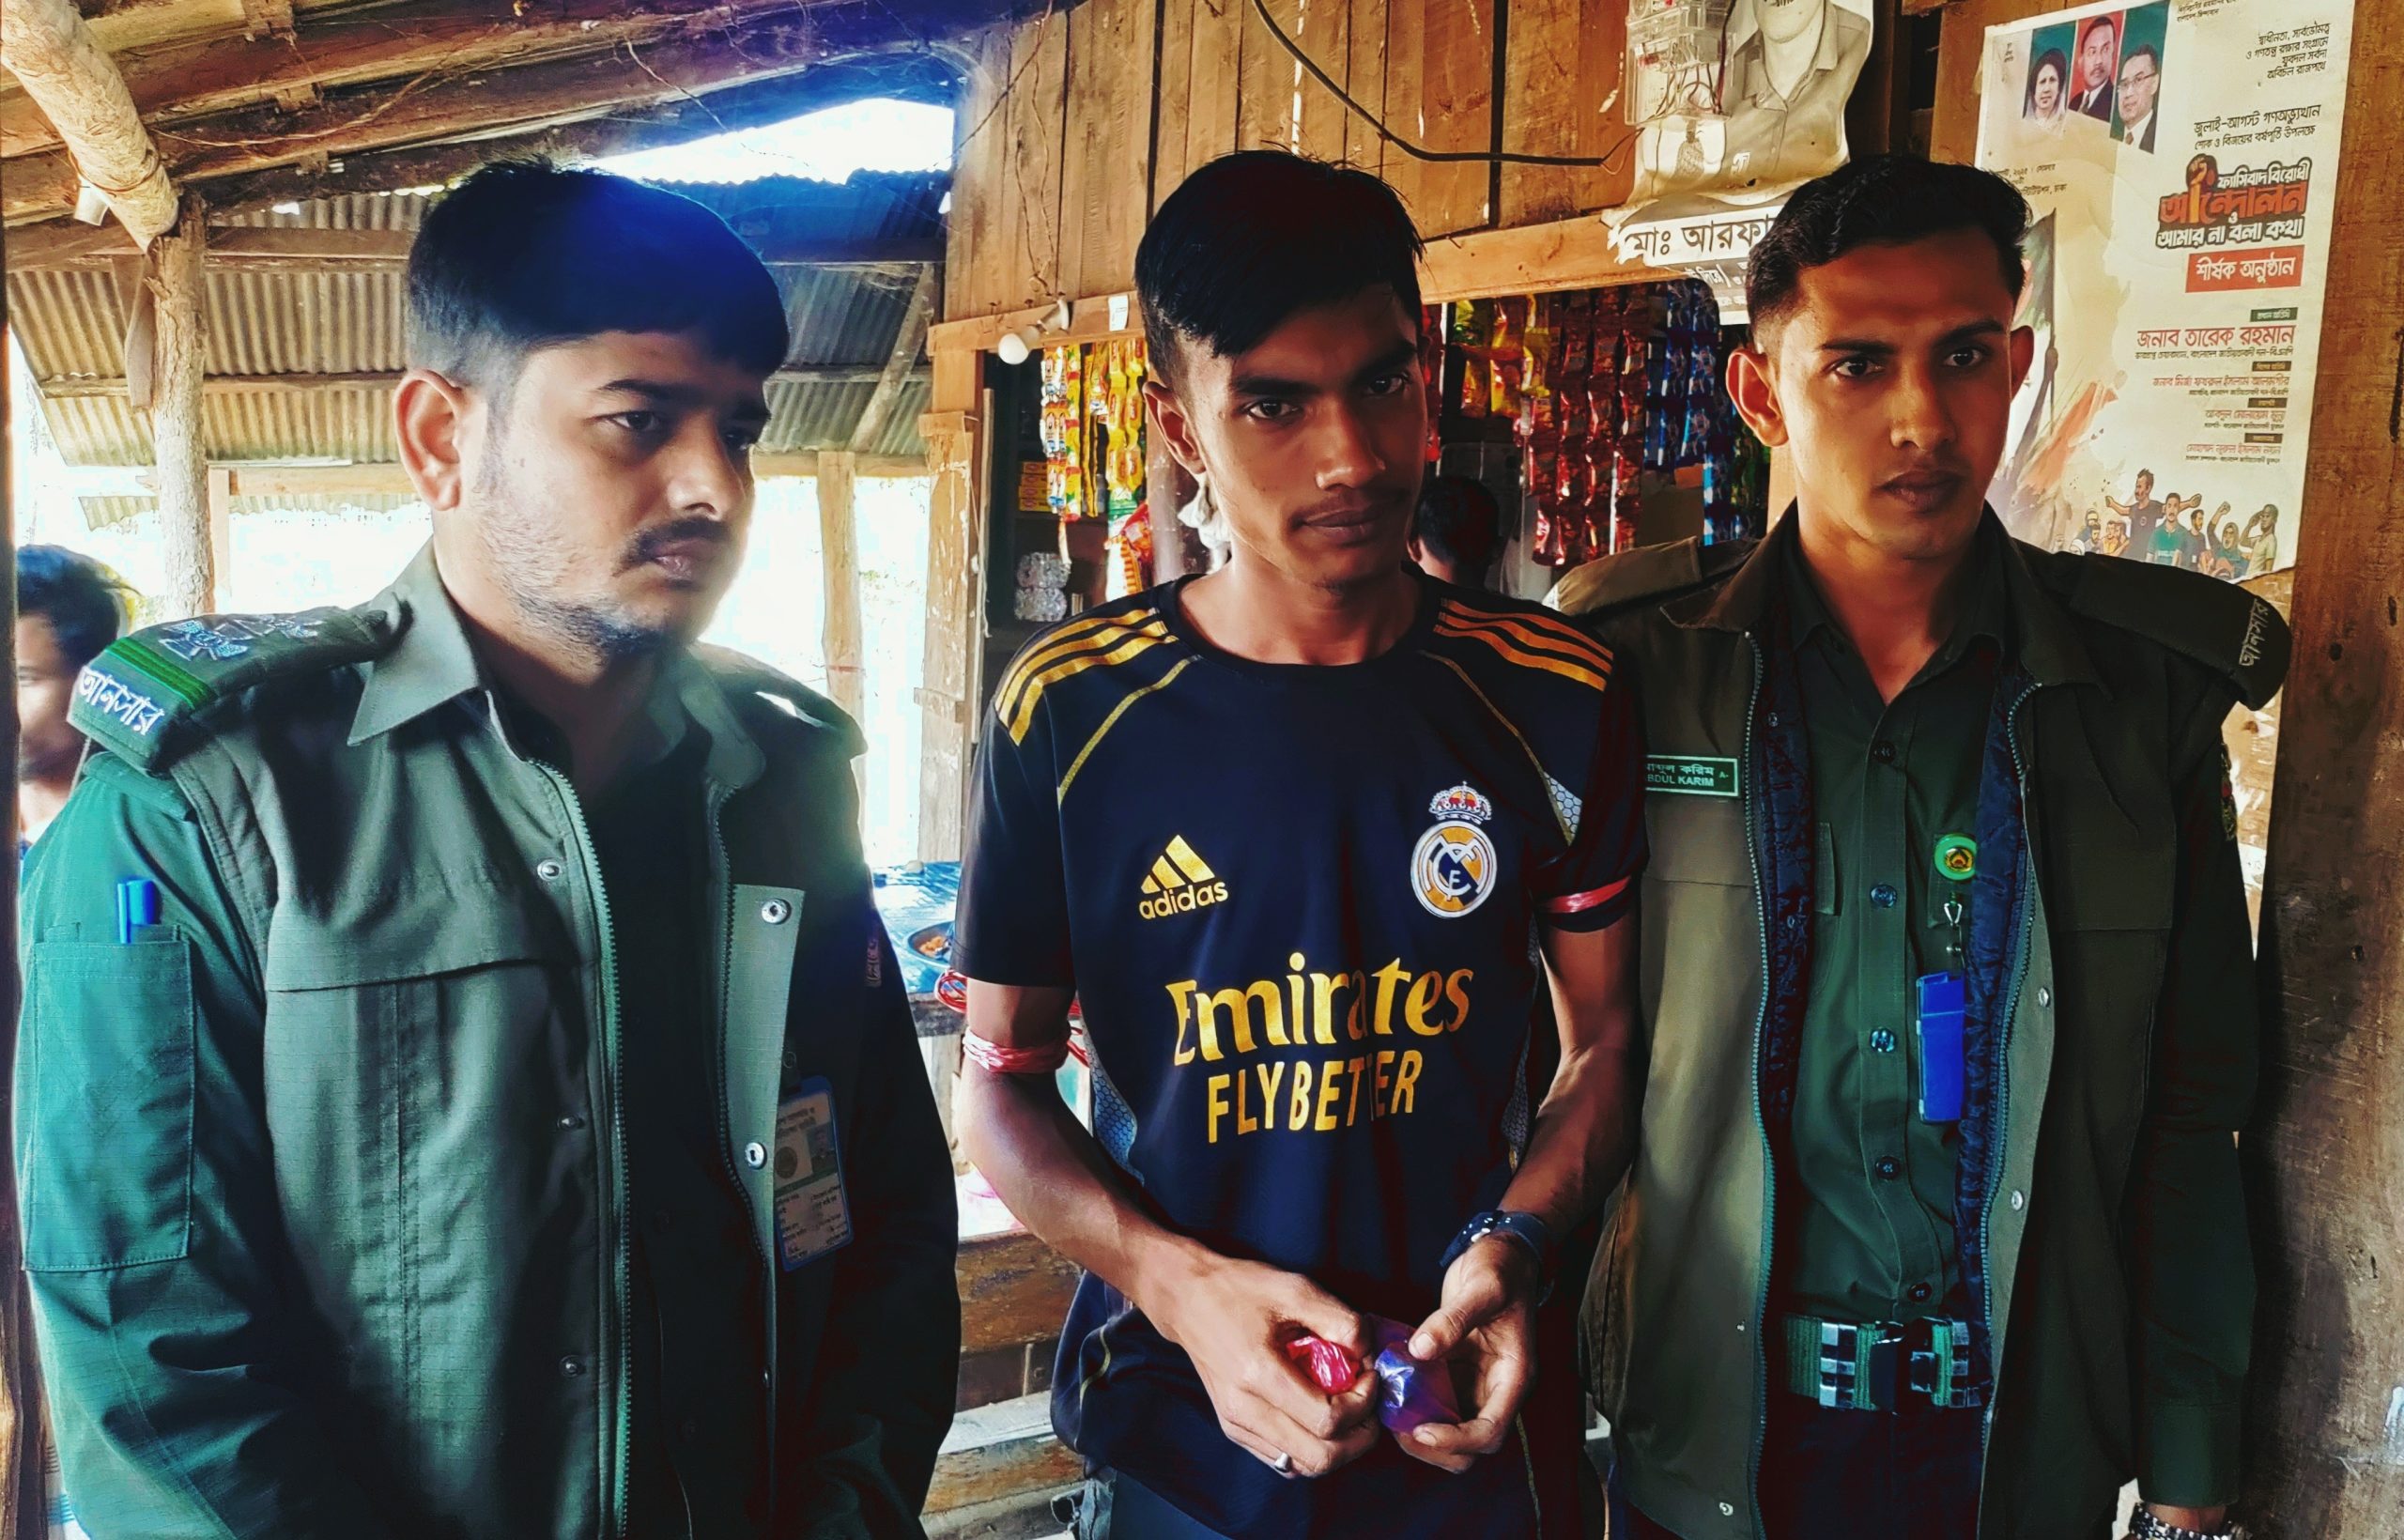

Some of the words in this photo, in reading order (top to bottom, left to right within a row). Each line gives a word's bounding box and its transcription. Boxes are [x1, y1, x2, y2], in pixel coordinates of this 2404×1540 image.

[1681, 213, 1778, 253] আরফা
[2157, 227, 2205, 248] আমার
[2207, 225, 2226, 243] না
[2228, 223, 2262, 242] বলা
[2266, 218, 2304, 239] কথা
[2196, 256, 2238, 281] শীর্ষক
[2240, 252, 2296, 284] অনুষ্ঠান
[2137, 330, 2181, 347] জনাব
[2184, 328, 2235, 347] তারেক
[2240, 325, 2296, 346] রহমান
[78, 666, 165, 736] আনসার
[1647, 774, 1676, 784] BDUL
[1678, 776, 1715, 787] KARIM
[1138, 881, 1229, 920] adidas
[1165, 952, 1474, 1066] Emirates
